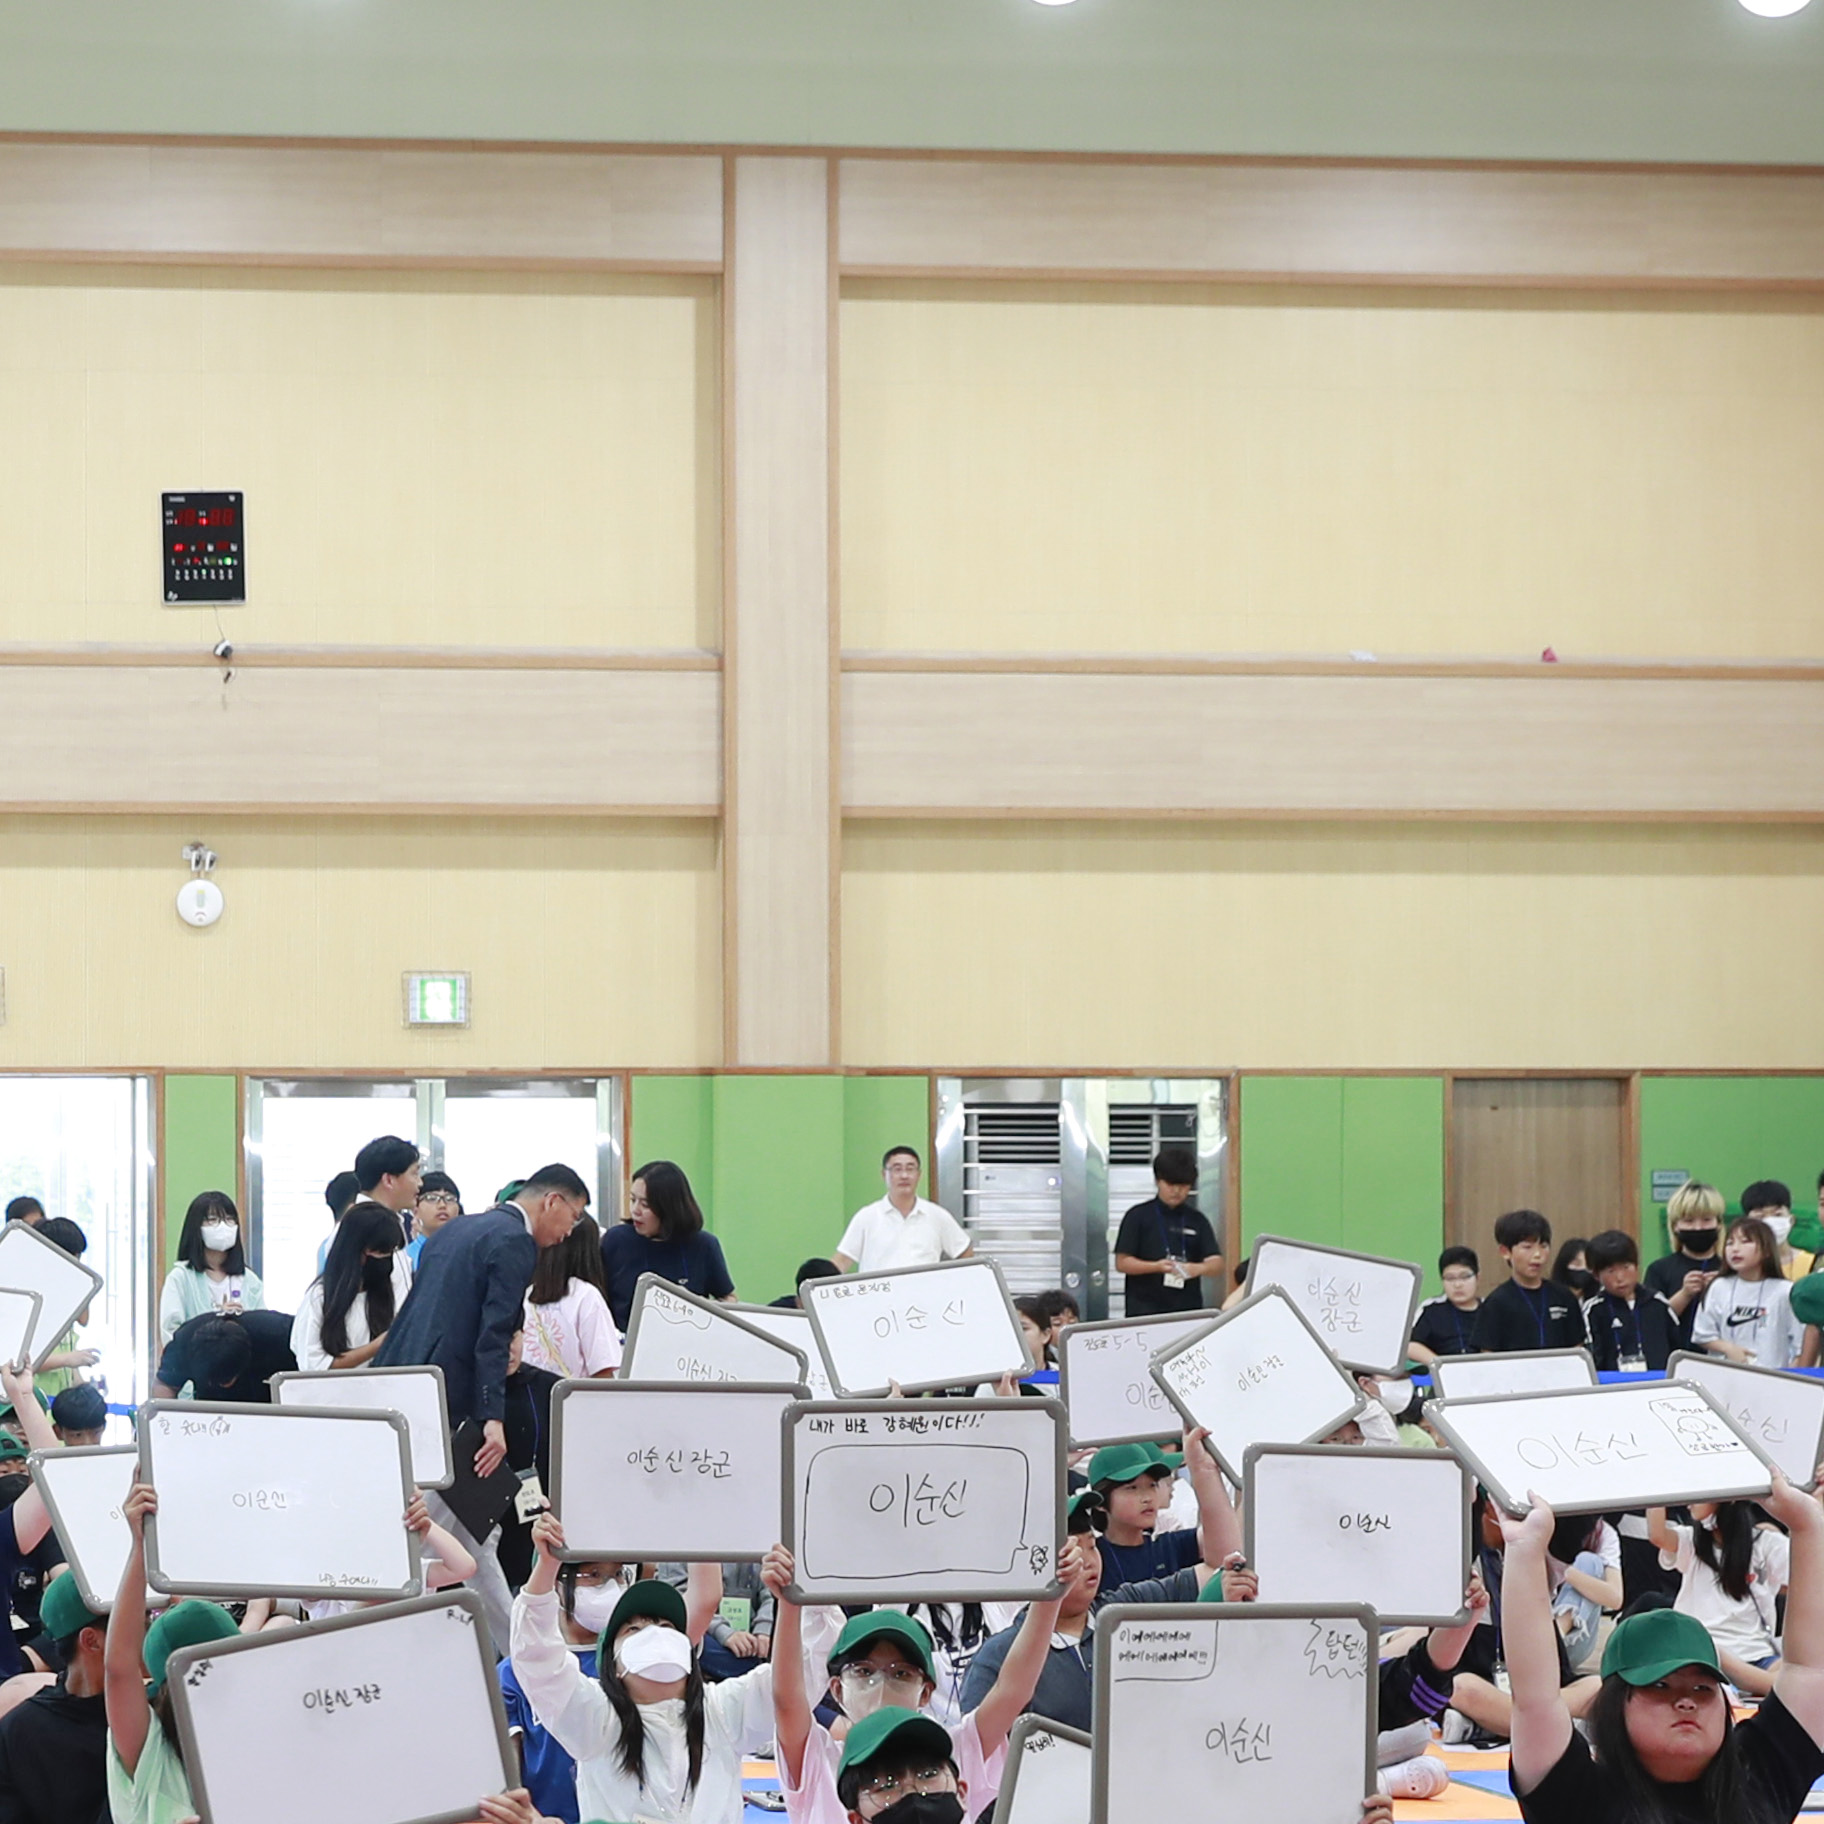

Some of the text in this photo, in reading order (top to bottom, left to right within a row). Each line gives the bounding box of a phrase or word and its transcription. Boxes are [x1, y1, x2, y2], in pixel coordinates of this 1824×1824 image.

[1307, 1276, 1363, 1306] 이순신
[873, 1299, 966, 1339] 이순신
[1320, 1306, 1364, 1334] 장군
[1113, 1332, 1149, 1352] 5-5
[1125, 1382, 1177, 1413] 이순
[808, 1416, 836, 1436] 내가
[844, 1416, 870, 1435] 바로
[626, 1445, 732, 1479] 이순신 장군
[1515, 1431, 1650, 1470] 이순신
[232, 1490, 288, 1510] 이순신
[868, 1472, 968, 1528] 이순신
[302, 1683, 382, 1714] 이순신 장군
[1204, 1716, 1274, 1764] 이순신
